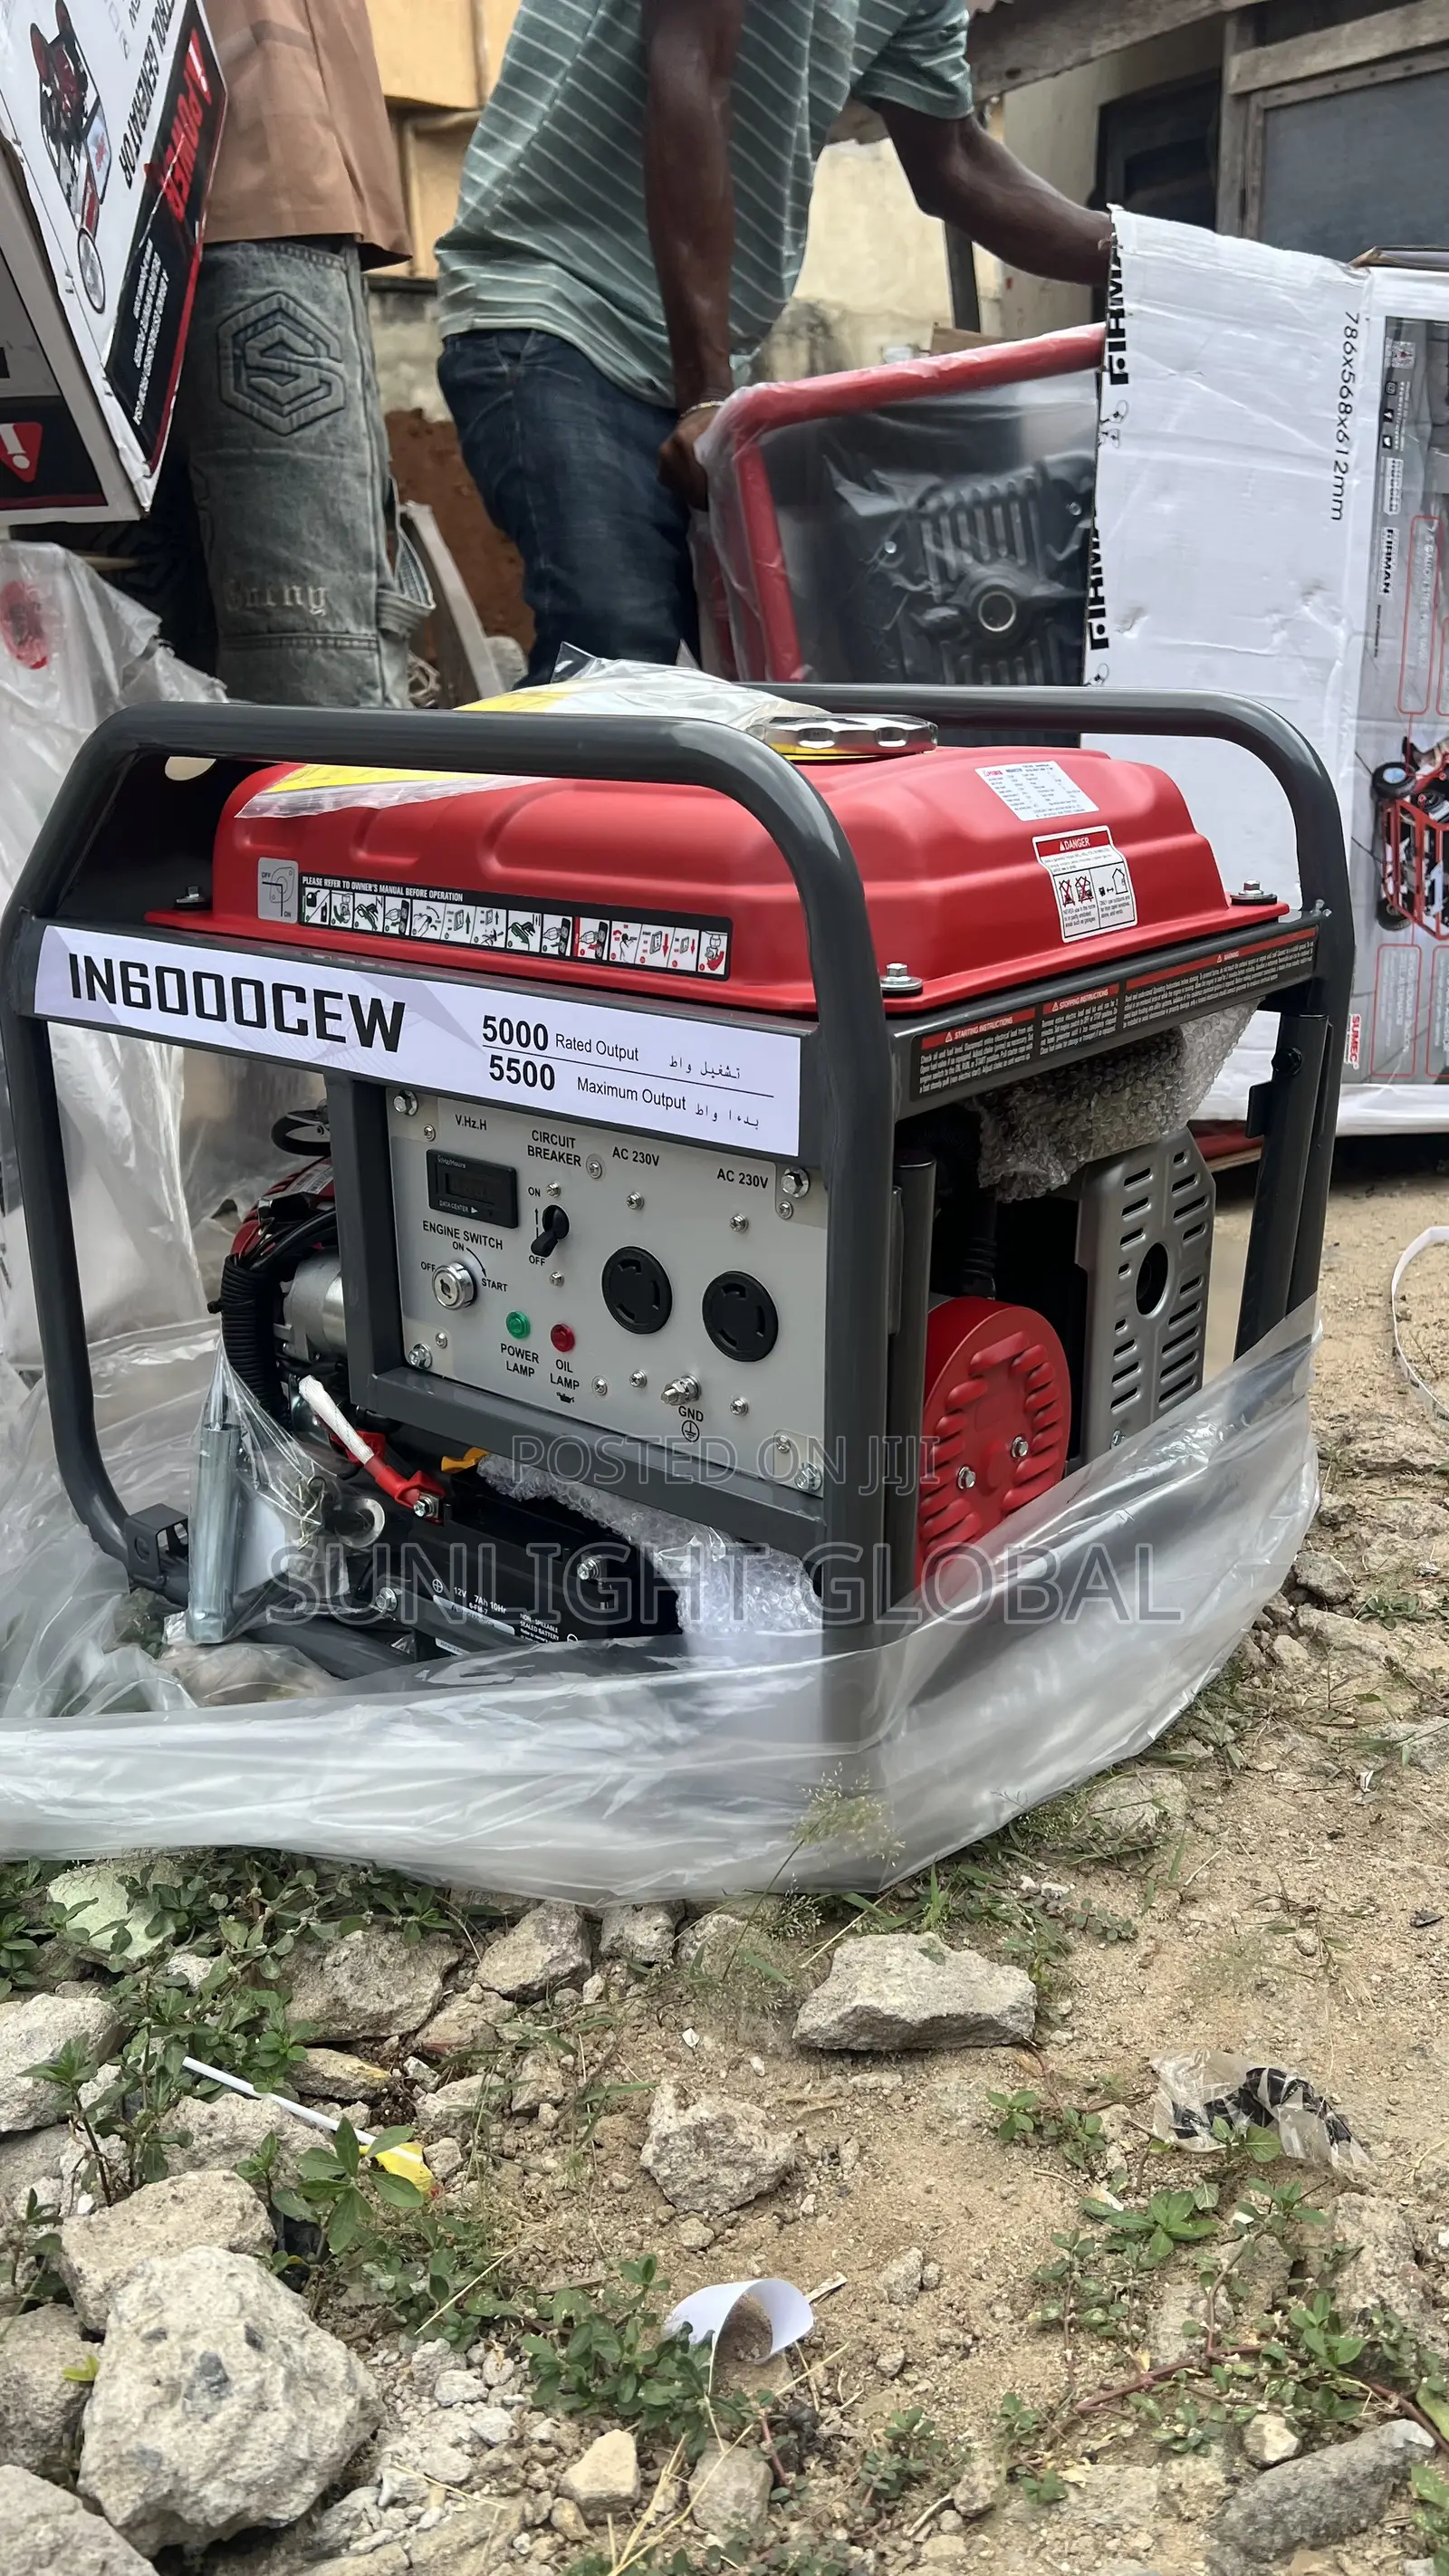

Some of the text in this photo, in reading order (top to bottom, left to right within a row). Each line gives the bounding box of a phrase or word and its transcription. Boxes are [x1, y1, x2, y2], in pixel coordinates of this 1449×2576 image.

[119, 34, 159, 190] GENERATOR
[1063, 837, 1090, 851] DANGER
[302, 876, 463, 902] PLEASE REFER TO OWNER'S MANUAL BEFORE OPERATION
[69, 953, 406, 1052] IN6000CEW
[1059, 989, 1108, 1010] STOPPING INSTRUCTIONS
[954, 1016, 1012, 1040] STARTING INSTRUCTIONS
[1350, 1014, 1360, 1062] SUMEC
[482, 1015, 638, 1062] 5000 Rated Output
[489, 1055, 686, 1112] 5500 Maximum Output
[455, 1114, 488, 1131] V.Hz.H
[532, 1130, 576, 1149] CIRCUIT
[527, 1144, 581, 1167] BREAKER
[612, 1146, 660, 1167] AC 230V
[716, 1168, 769, 1190] AC 230V
[528, 1186, 541, 1196] ON
[422, 1221, 504, 1250] ENGINE SWITCH
[453, 1241, 465, 1251] ON
[420, 1261, 437, 1272] OFF
[529, 1255, 546, 1267] OFF
[481, 1278, 508, 1292] START
[500, 1343, 540, 1365] POWER
[505, 1361, 535, 1378] LAMP
[555, 1359, 574, 1374] OIL
[550, 1373, 580, 1390] LAMP
[678, 1405, 705, 1422] GND
[454, 1587, 506, 1614] 12V 7Ah 10Hr
[469, 1603, 488, 1614] 6-FM-7
[520, 1621, 537, 1633] SEALED
[538, 1626, 559, 1641] BATTERY
